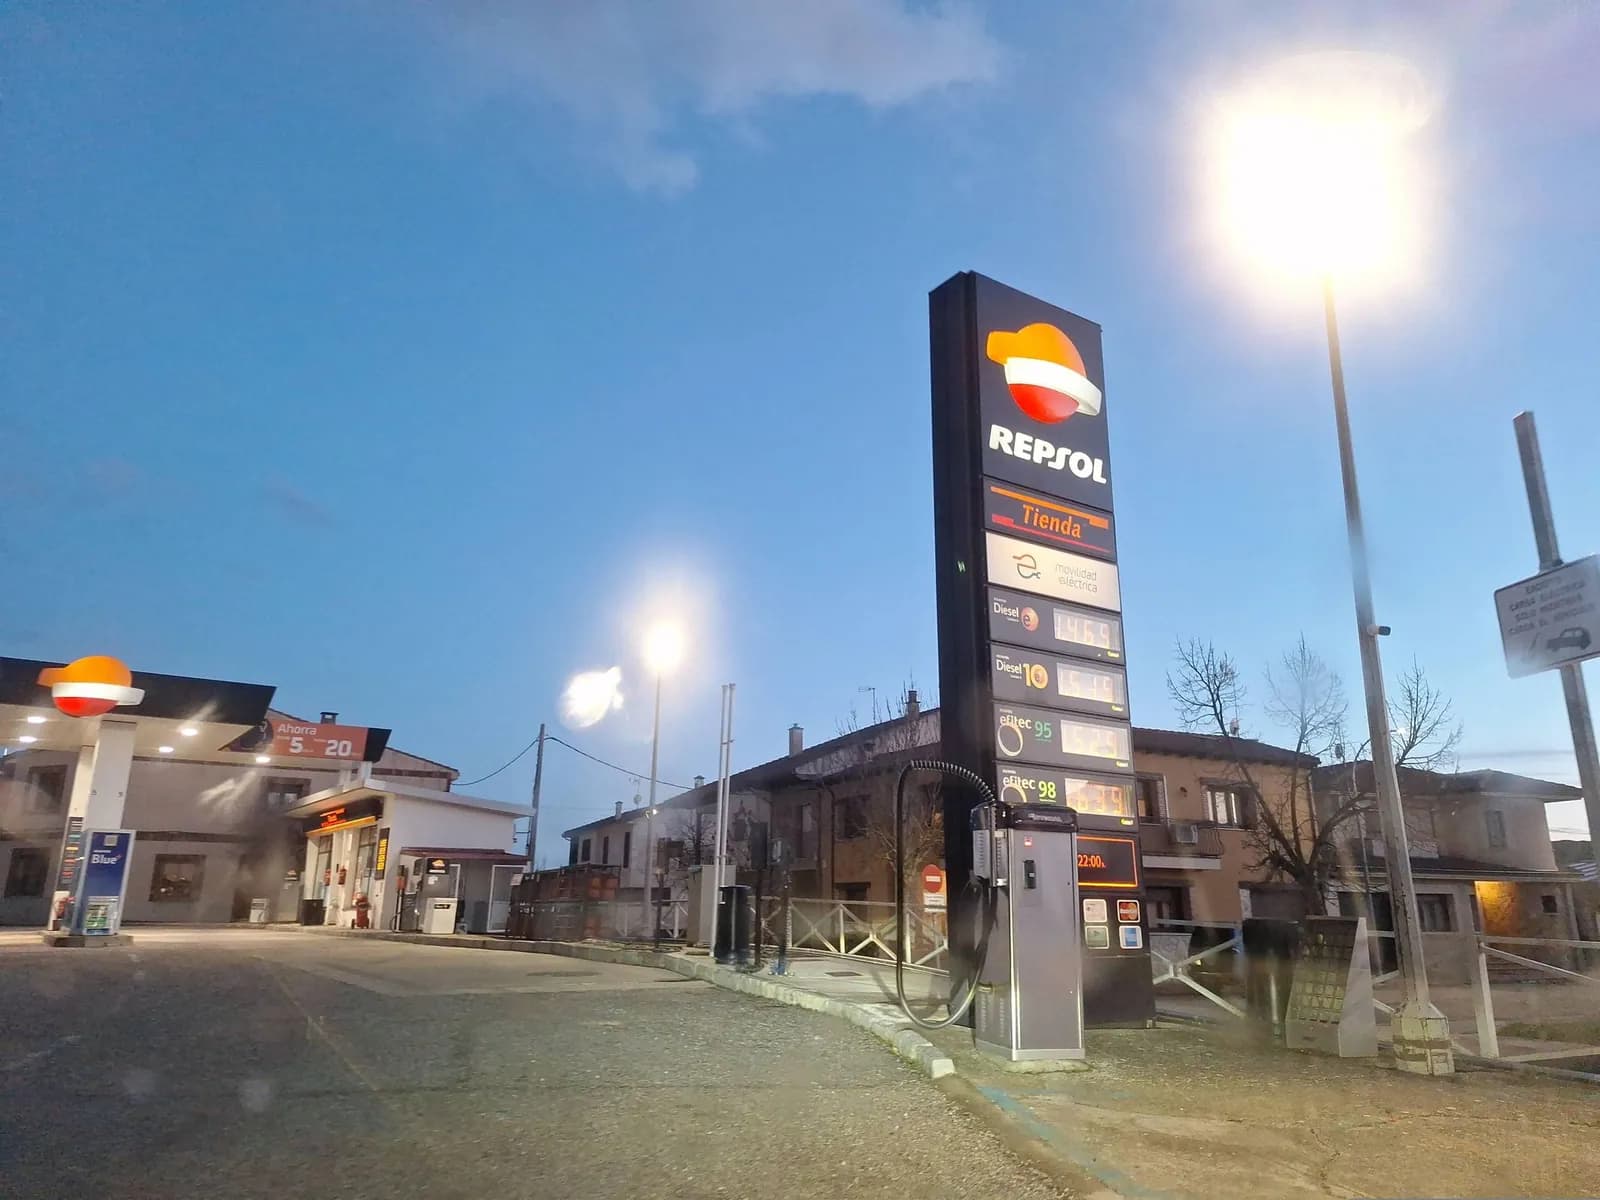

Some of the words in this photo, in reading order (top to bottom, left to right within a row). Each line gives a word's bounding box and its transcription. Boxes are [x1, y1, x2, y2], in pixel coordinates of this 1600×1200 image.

[989, 424, 1107, 485] REPSOL
[1023, 504, 1082, 539] Tienda
[1055, 563, 1097, 581] movilidad
[993, 602, 1020, 618] Diesel
[996, 659, 1022, 674] Diesel
[277, 723, 318, 736] Ahorra
[1000, 714, 1032, 729] efitec
[1034, 720, 1052, 739] 95
[289, 737, 303, 753] 5
[324, 740, 352, 757] 20
[1002, 775, 1036, 790] efitec
[1038, 780, 1057, 799] 98
